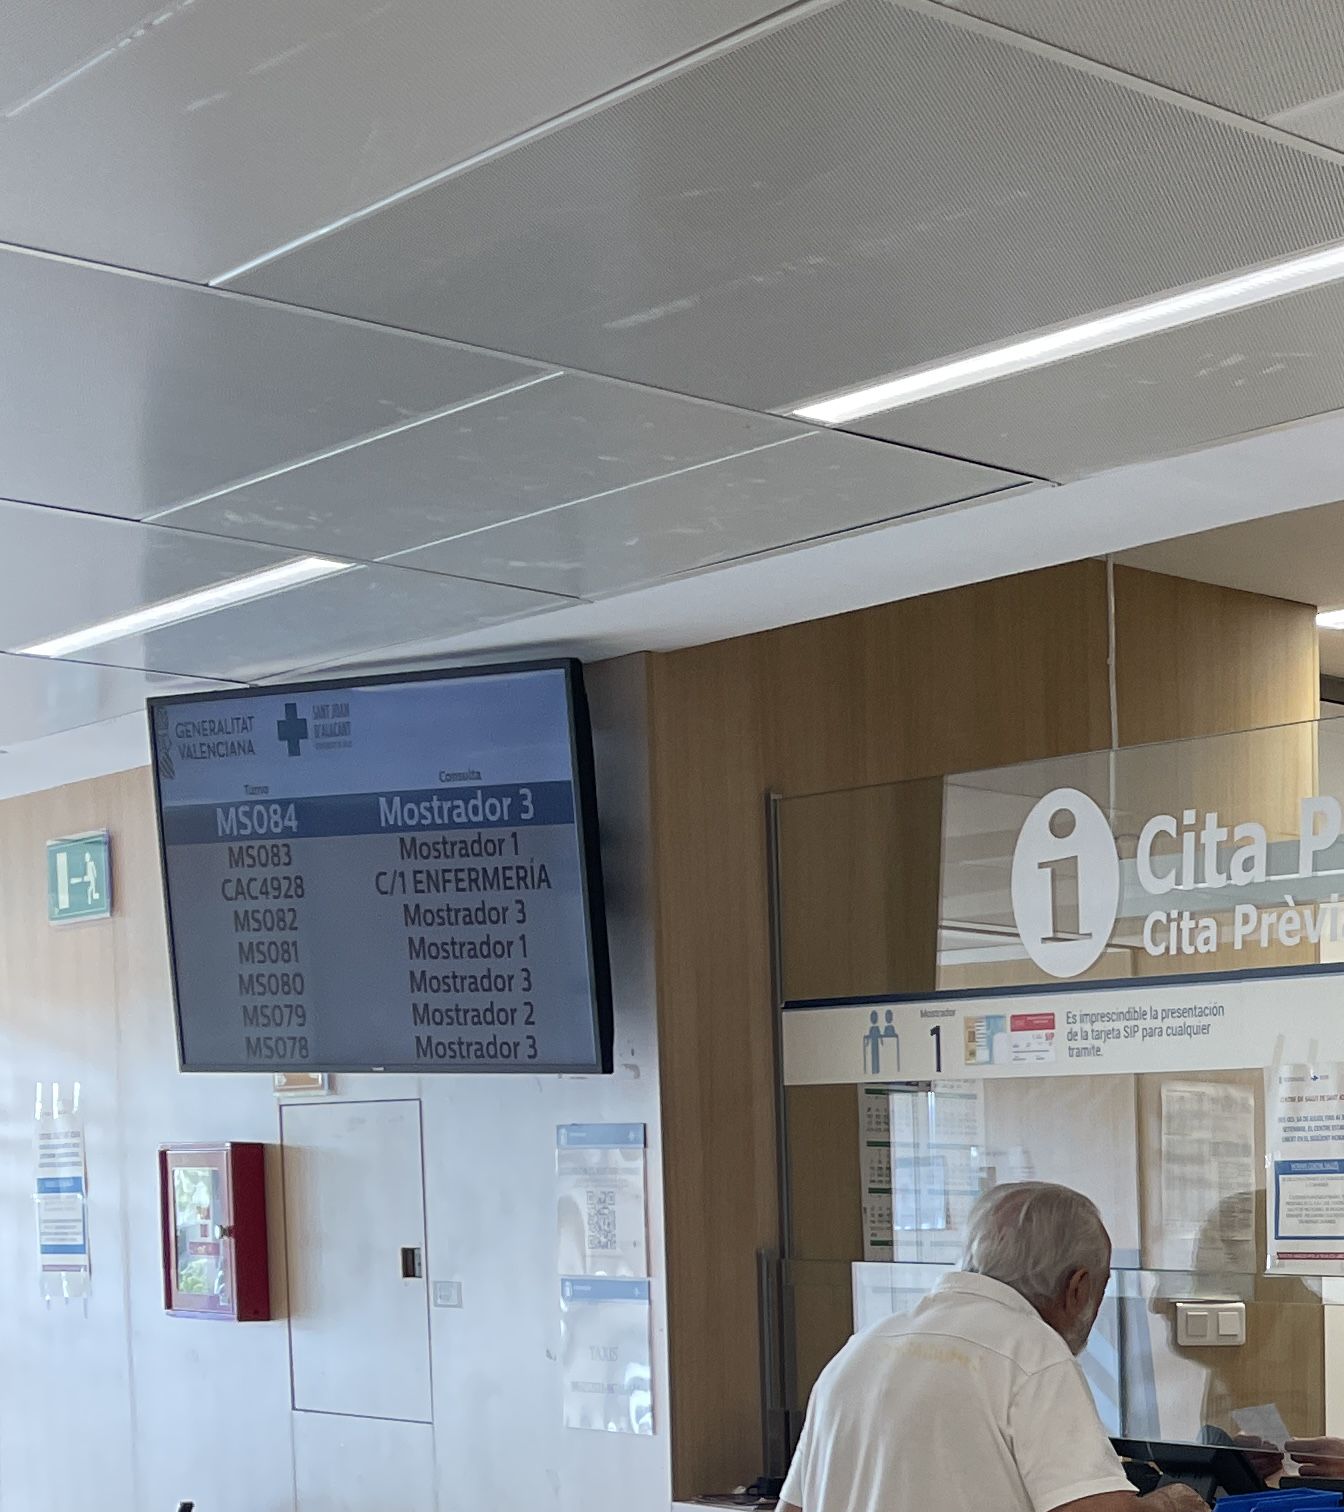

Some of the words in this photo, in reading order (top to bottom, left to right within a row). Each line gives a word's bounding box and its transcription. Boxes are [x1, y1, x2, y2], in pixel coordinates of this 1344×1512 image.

[175, 716, 255, 739] GENERALITAT
[177, 739, 256, 760] VALENCIANA
[216, 803, 298, 837] MS084
[379, 789, 512, 827] Mostrador
[519, 787, 535, 820] 3
[228, 843, 292, 869] MS083
[399, 832, 505, 860] Mostrador
[511, 832, 519, 855] 1
[1136, 808, 1266, 896] Cita
[221, 875, 305, 901] CAC4928
[375, 869, 407, 896] C/1
[414, 857, 551, 894] ENFERMERÍA
[234, 908, 298, 933] MS082
[403, 900, 508, 928] Mostrador
[515, 899, 527, 925] 3
[1143, 909, 1217, 957] Cita
[238, 941, 299, 964] MS081
[408, 933, 513, 960] Mostrador
[519, 934, 527, 958] 1
[238, 972, 305, 996] MS080
[409, 967, 515, 994] Mostrador
[521, 967, 532, 992] 3
[242, 1004, 307, 1027] MS079
[412, 1001, 517, 1027] Mostrador
[524, 1001, 535, 1026] 2
[1066, 1011, 1077, 1025] Es
[1079, 1009, 1147, 1027] imprescindible
[1150, 1008, 1159, 1020] la
[1161, 1003, 1224, 1021] presentación
[1066, 1028, 1078, 1042] de
[1080, 1027, 1089, 1041] la
[1091, 1025, 1120, 1044] tarjeta
[1124, 1024, 1139, 1040] SIP
[1141, 1026, 1163, 1042] para
[1165, 1021, 1211, 1040] cualquier
[245, 1036, 309, 1060] MS078
[415, 1034, 520, 1060] Mostrador
[527, 1034, 538, 1060] 3
[929, 1025, 942, 1073] 1
